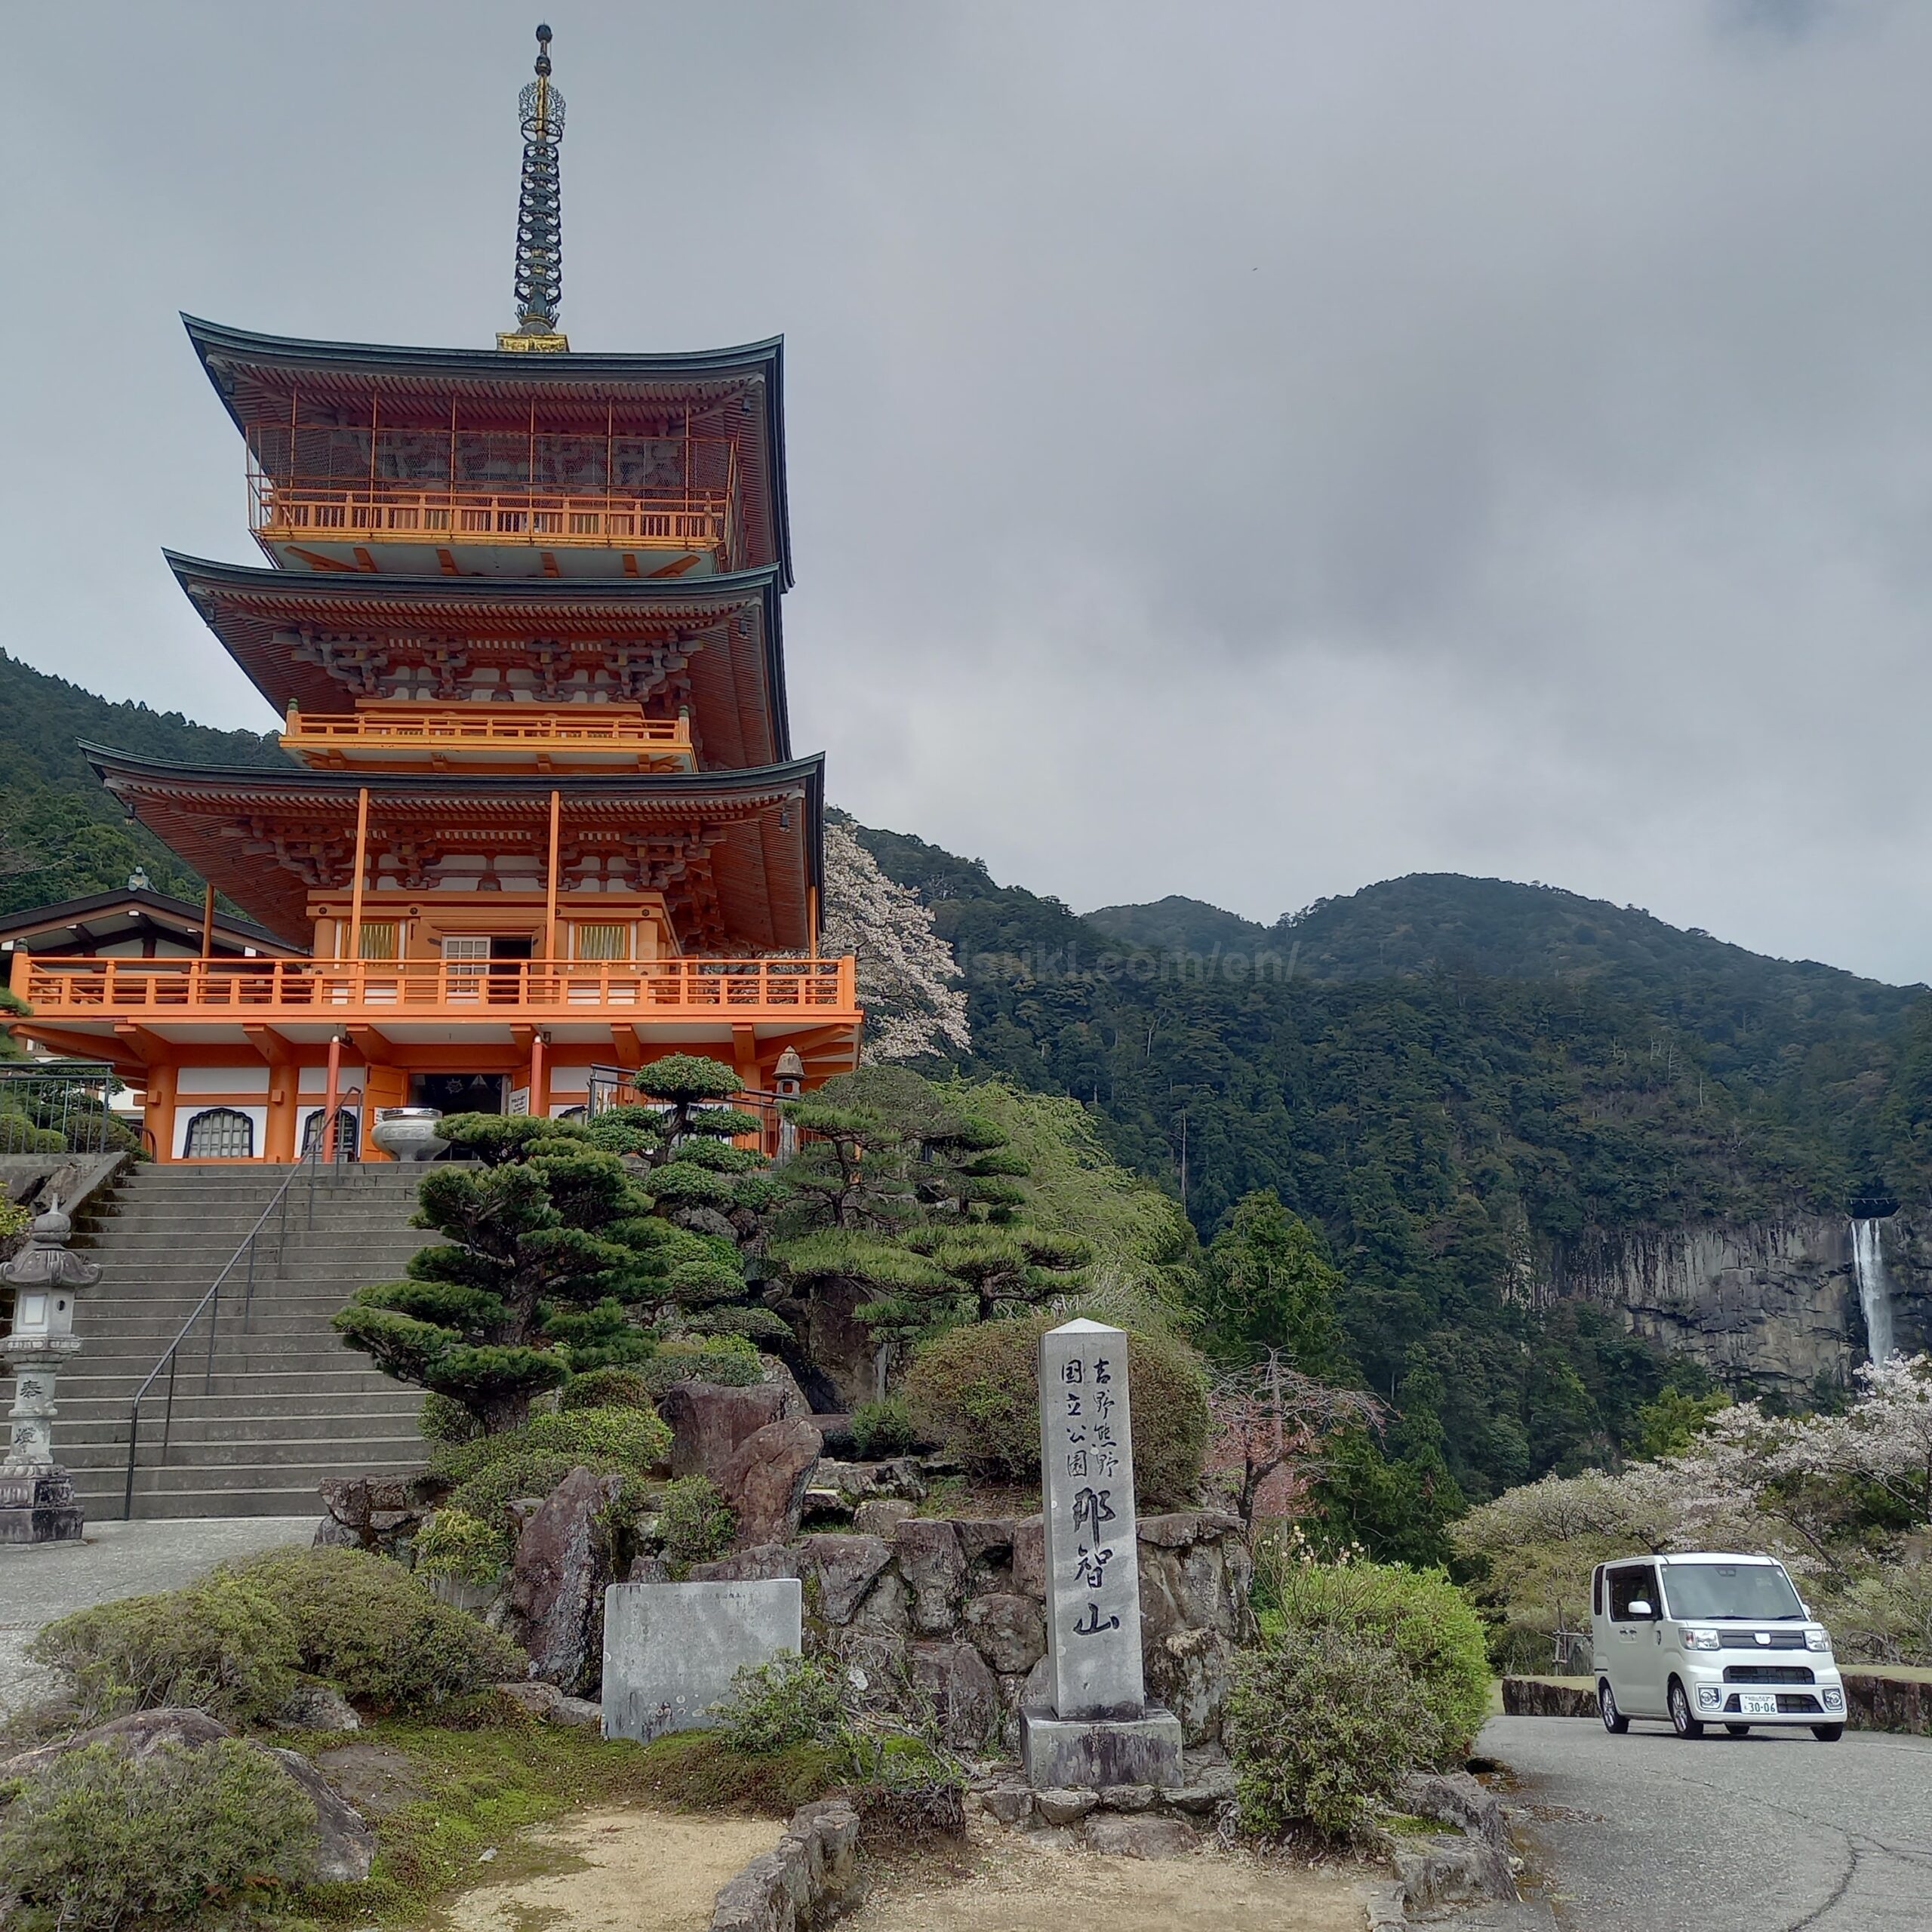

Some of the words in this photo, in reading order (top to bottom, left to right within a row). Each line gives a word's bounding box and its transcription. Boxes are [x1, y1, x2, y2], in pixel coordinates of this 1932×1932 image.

[1092, 1357, 1118, 1478] 吉野熊野
[1072, 1487, 1120, 1635] 那智山
